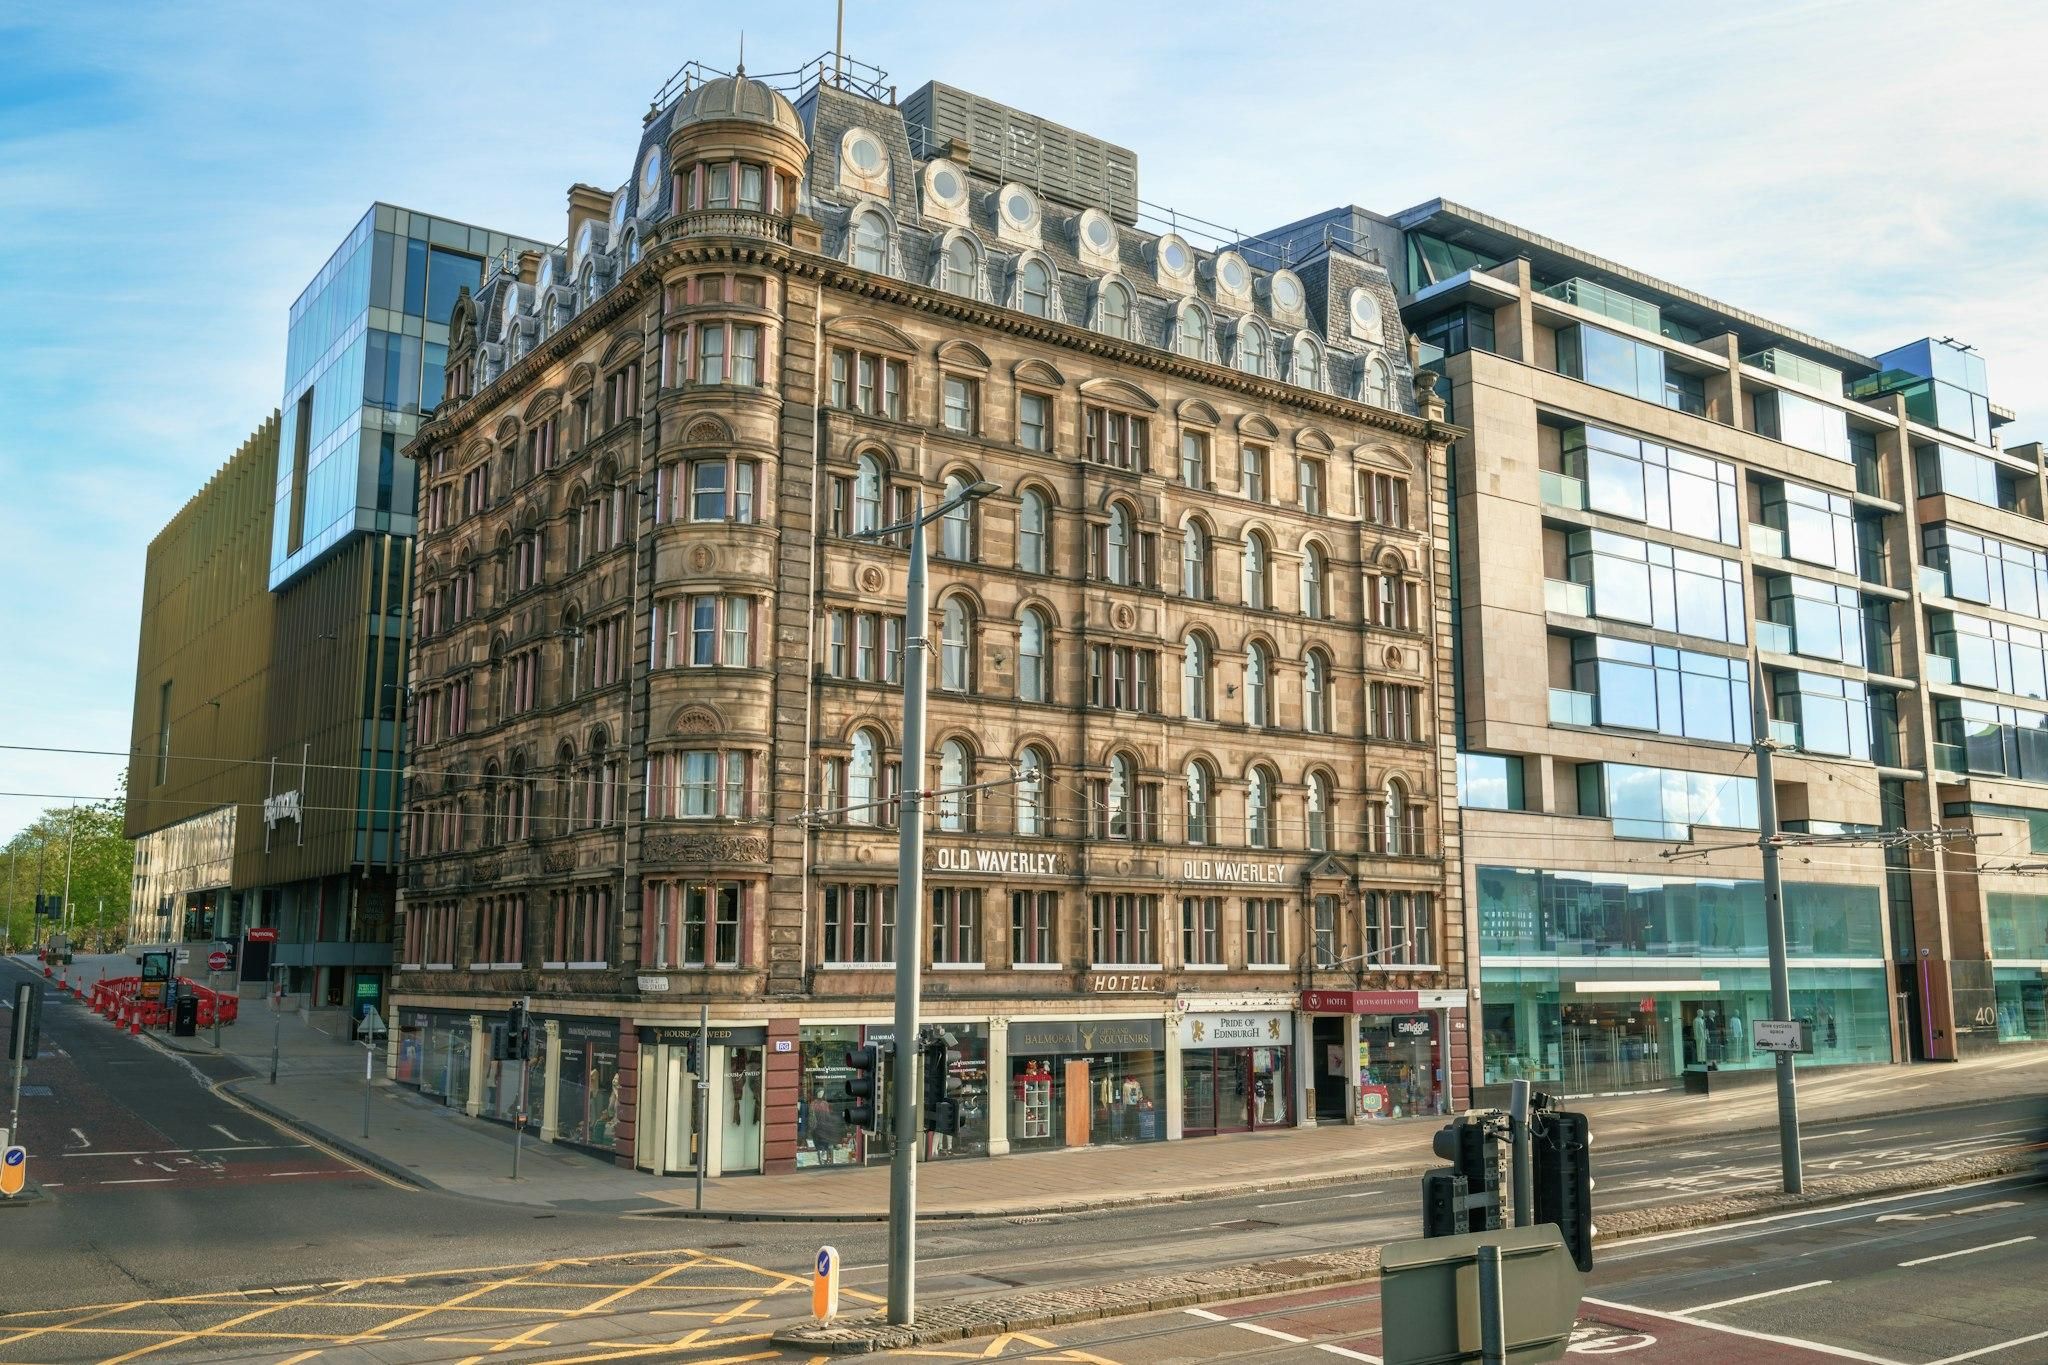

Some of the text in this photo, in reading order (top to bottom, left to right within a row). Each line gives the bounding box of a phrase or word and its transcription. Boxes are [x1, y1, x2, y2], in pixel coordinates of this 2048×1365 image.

[937, 848, 1057, 874] OLD WAVERLEY
[1183, 860, 1285, 883] OLD WAVERLEY
[1326, 997, 1347, 1006] HOTEL
[1975, 1006, 1995, 1025] 40
[1220, 1018, 1255, 1028] PRIDE OF
[704, 1031, 732, 1039] WEED
[1099, 1033, 1149, 1045] SOUVENIRS
[1214, 1027, 1260, 1039] EDINBURGH
[1024, 1034, 1077, 1045] BALMORAL
